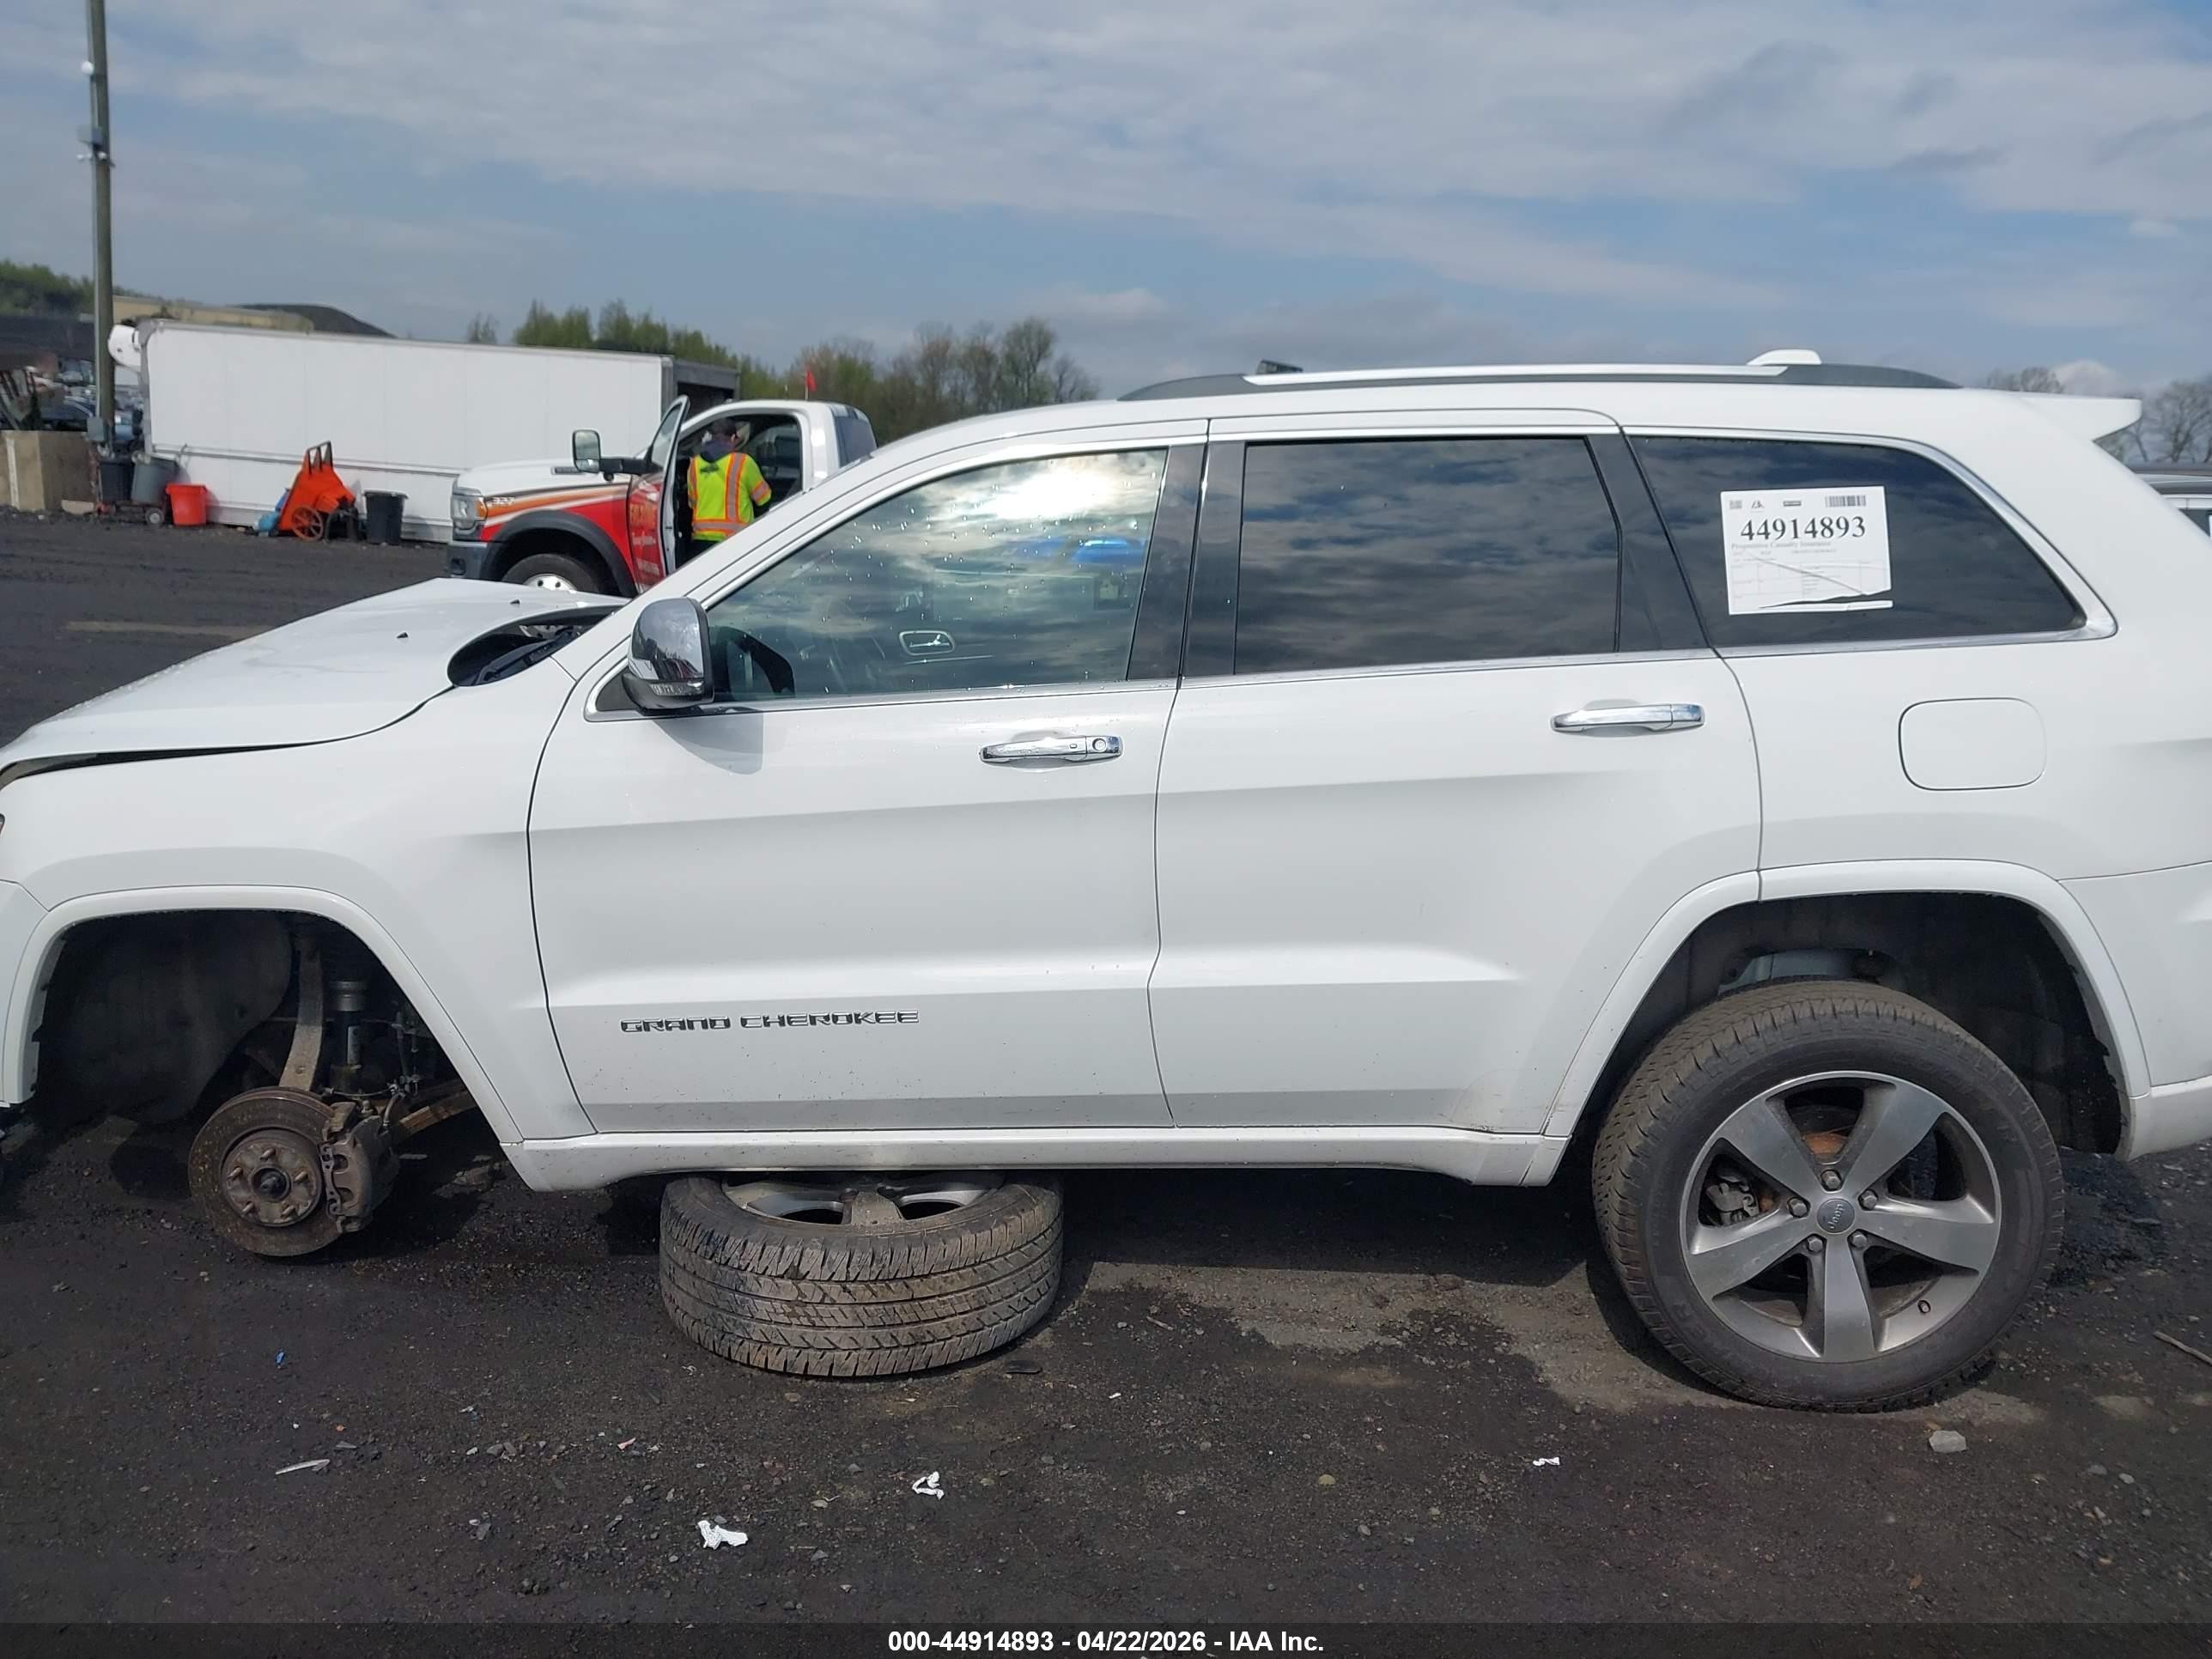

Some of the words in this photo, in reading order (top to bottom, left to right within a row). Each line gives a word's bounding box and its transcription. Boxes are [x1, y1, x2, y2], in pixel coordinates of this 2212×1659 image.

[1741, 516, 1866, 541] 44914893
[620, 1015, 731, 1032] GRAND
[740, 1010, 920, 1029] CHEROKEE
